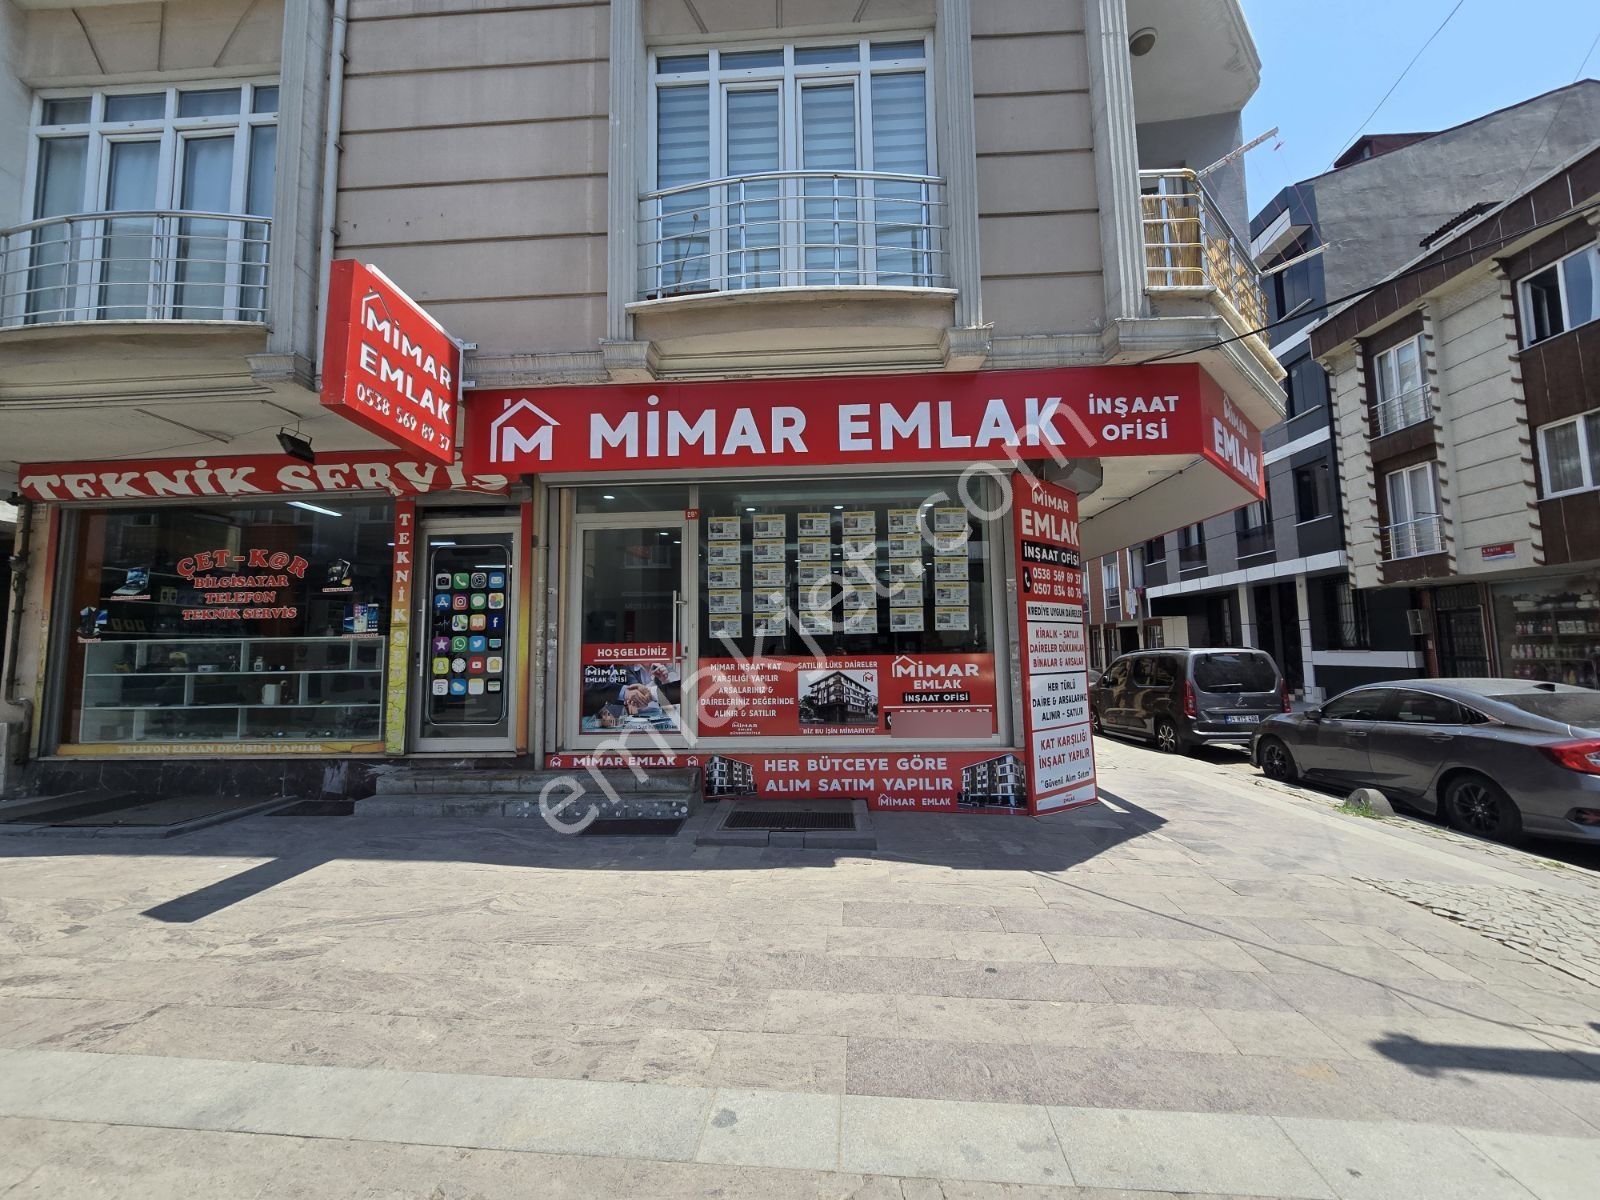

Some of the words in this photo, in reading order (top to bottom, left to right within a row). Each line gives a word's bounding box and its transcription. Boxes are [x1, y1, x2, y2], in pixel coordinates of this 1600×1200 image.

[367, 306, 451, 391] MİMAR
[359, 342, 450, 425] EMLAK
[1088, 393, 1179, 419] İNŞAAT
[356, 383, 391, 416] 0538
[396, 407, 417, 431] 569
[421, 423, 435, 442] 89
[439, 433, 450, 451] 37
[589, 395, 808, 460] MİMAR
[838, 397, 1065, 452] EMLAK
[1102, 419, 1169, 442] OFİSİ
[1213, 416, 1259, 487] EMLAK
[21, 459, 273, 500] TEKNİK
[1033, 486, 1070, 514] MİMAR
[1021, 508, 1079, 547] EMLAK
[1024, 542, 1059, 563] İNŞAAT
[1061, 549, 1080, 567] OFİSİ
[394, 513, 411, 622] TEKNİK
[194, 573, 289, 589] BİLGİSAYAR
[1033, 567, 1051, 580] 0538
[1053, 569, 1065, 583] 569
[1066, 572, 1074, 584] 89
[1075, 573, 1082, 585] 37
[1033, 582, 1051, 595] 0507
[204, 591, 277, 604] TELEFON
[181, 607, 242, 620] TEKNİK
[243, 605, 297, 619] SERVİS
[1028, 605, 1050, 616] KREDİYE
[1035, 627, 1058, 638] KİRALIK
[597, 646, 668, 659] HOŞGELDİNİZ
[1030, 642, 1058, 653] DAİRELER
[710, 663, 735, 671] MİMAR
[737, 662, 765, 672] İNŞAAT
[767, 662, 782, 670] KAT
[825, 659, 842, 669] LÜKS
[844, 659, 878, 669] DAİRELER
[1033, 657, 1058, 668] BİNALAR
[1065, 657, 1084, 666] ARSALAR
[586, 666, 627, 676] MİMAR
[896, 661, 979, 678] MİMAR
[751, 674, 779, 682] YAPILIR
[718, 686, 766, 694] ARSALARINIZ
[913, 680, 962, 690] EMLAK
[1047, 682, 1059, 692] HER
[1060, 678, 1076, 690] TÜRLÜ
[700, 696, 750, 706] DAİRELERİNİZ
[752, 695, 795, 705] DEĞERİNDE
[904, 691, 939, 703] İNŞAAT
[943, 691, 969, 701] OFİSİ
[1032, 696, 1051, 708] DAİRE
[714, 709, 738, 717] ALINIR
[749, 709, 777, 717] SATILIR
[1042, 710, 1061, 722] ALINIR
[1066, 707, 1083, 718] SATILIR
[174, 745, 214, 753] EKRAN
[1040, 738, 1056, 750] KAT
[573, 754, 623, 766] MİMAR
[628, 755, 676, 766] EMLAK
[764, 759, 800, 772] HER
[896, 754, 948, 771] GÖRE
[1038, 752, 1066, 770] İNŞAAT
[1068, 749, 1090, 762] YAPILIR
[765, 779, 811, 792] ALIM
[818, 778, 875, 791] SATIM
[882, 778, 953, 791] YAPILIR
[879, 796, 916, 806] MİMAR
[921, 798, 951, 806] EMLAK
